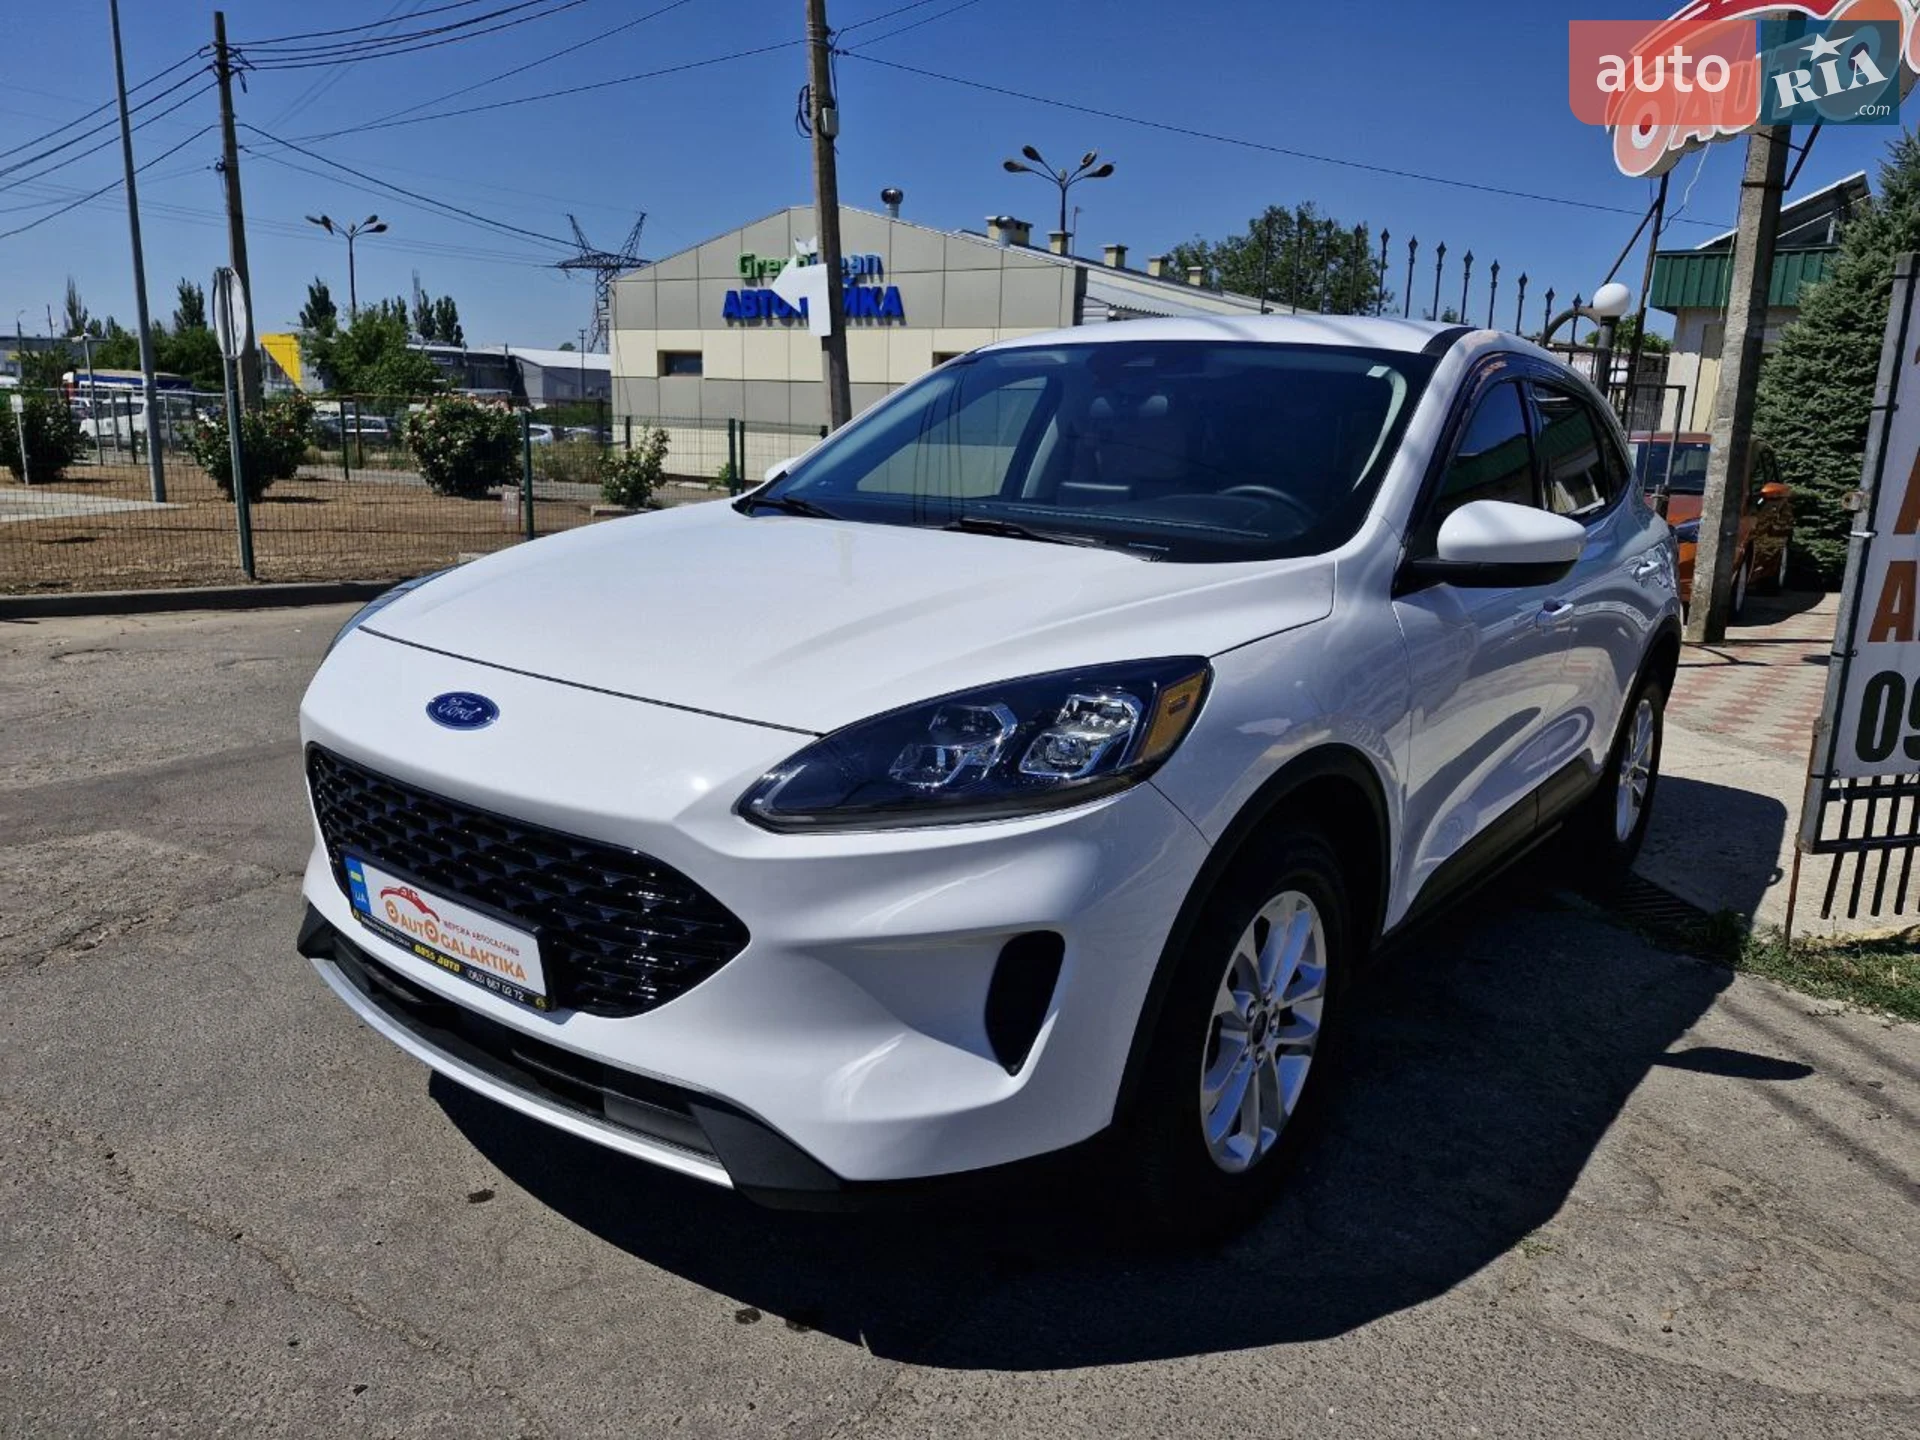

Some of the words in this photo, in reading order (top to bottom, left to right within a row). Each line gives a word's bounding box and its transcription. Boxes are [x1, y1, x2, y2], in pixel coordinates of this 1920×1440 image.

[723, 277, 905, 319] АВТОЙКА
[438, 697, 482, 720] Ford
[438, 954, 460, 972] AUTO
